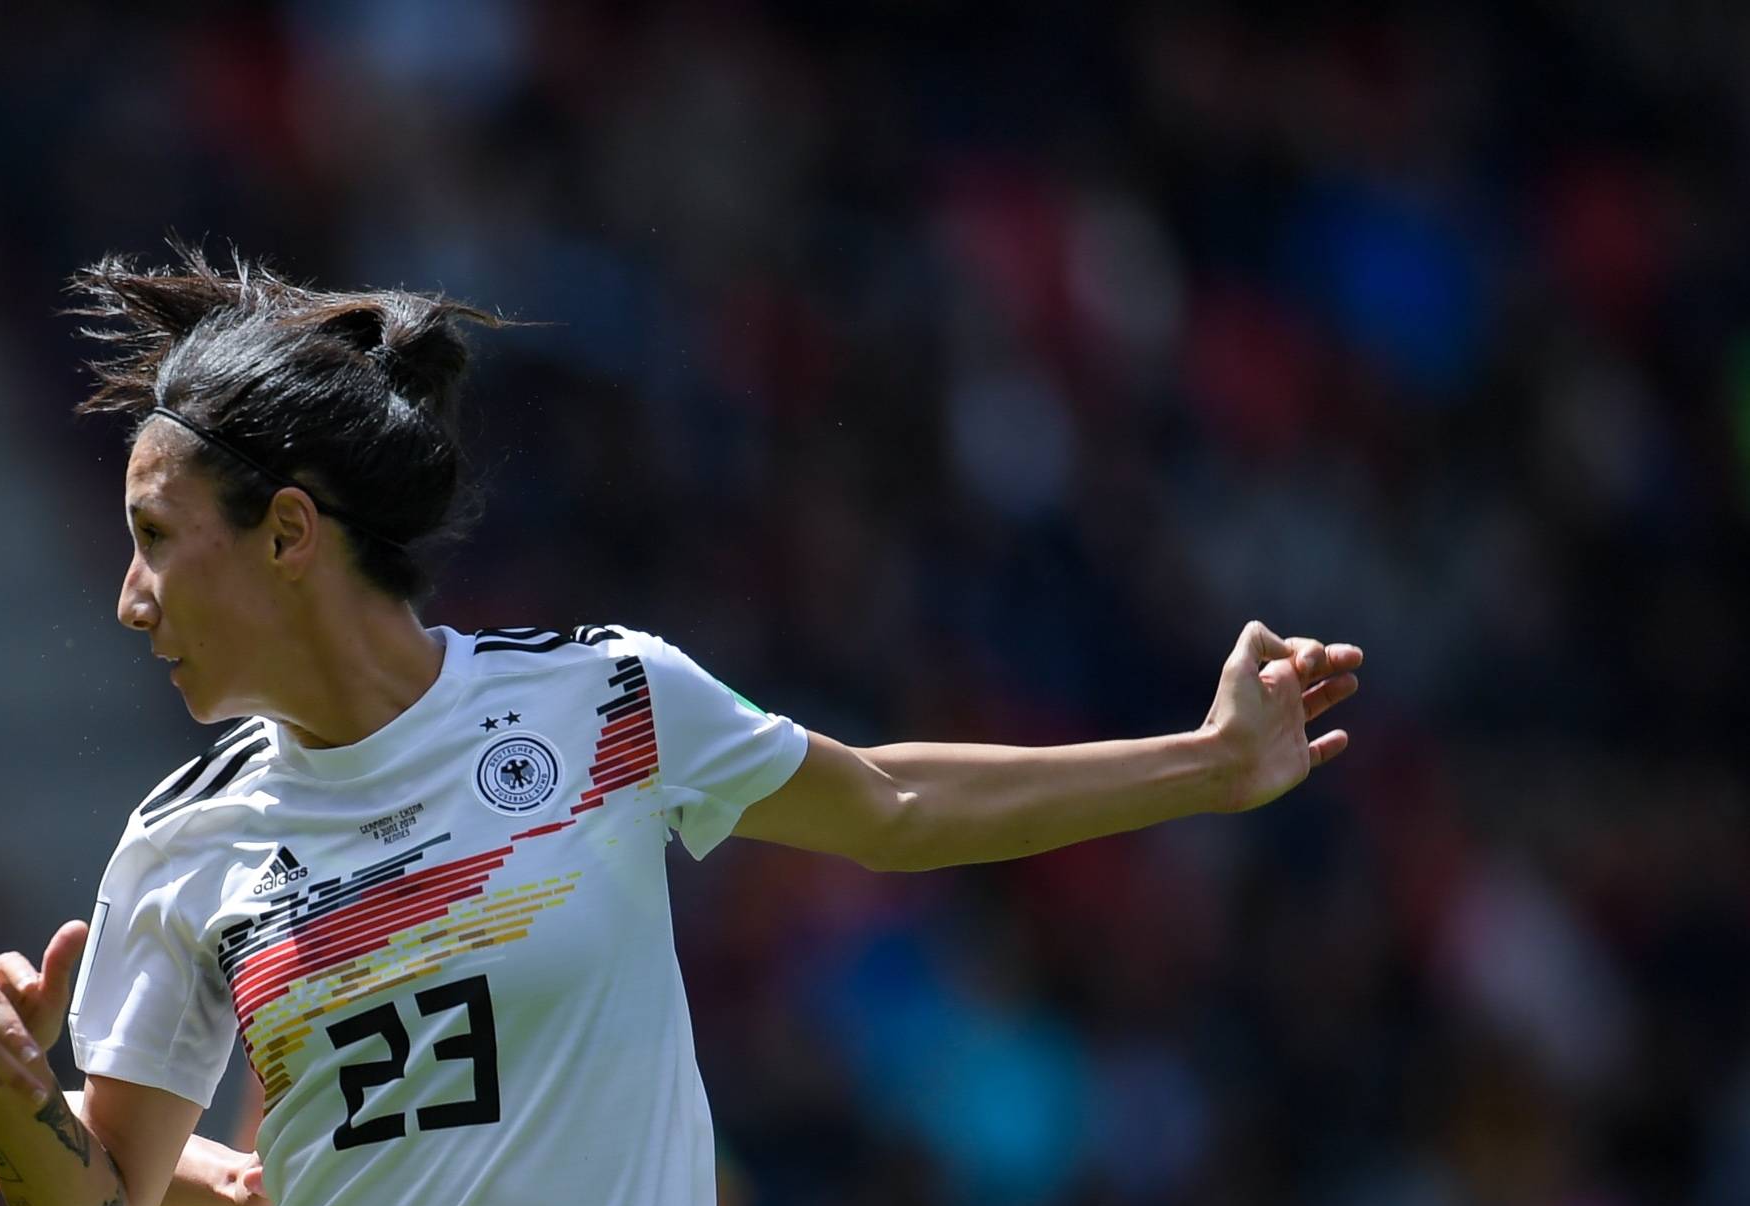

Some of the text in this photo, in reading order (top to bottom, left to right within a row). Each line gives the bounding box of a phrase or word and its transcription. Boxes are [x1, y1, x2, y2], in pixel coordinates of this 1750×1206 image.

[489, 746, 535, 768] DEUTSCHER
[252, 865, 309, 896] adidas
[325, 973, 502, 1152] 23
